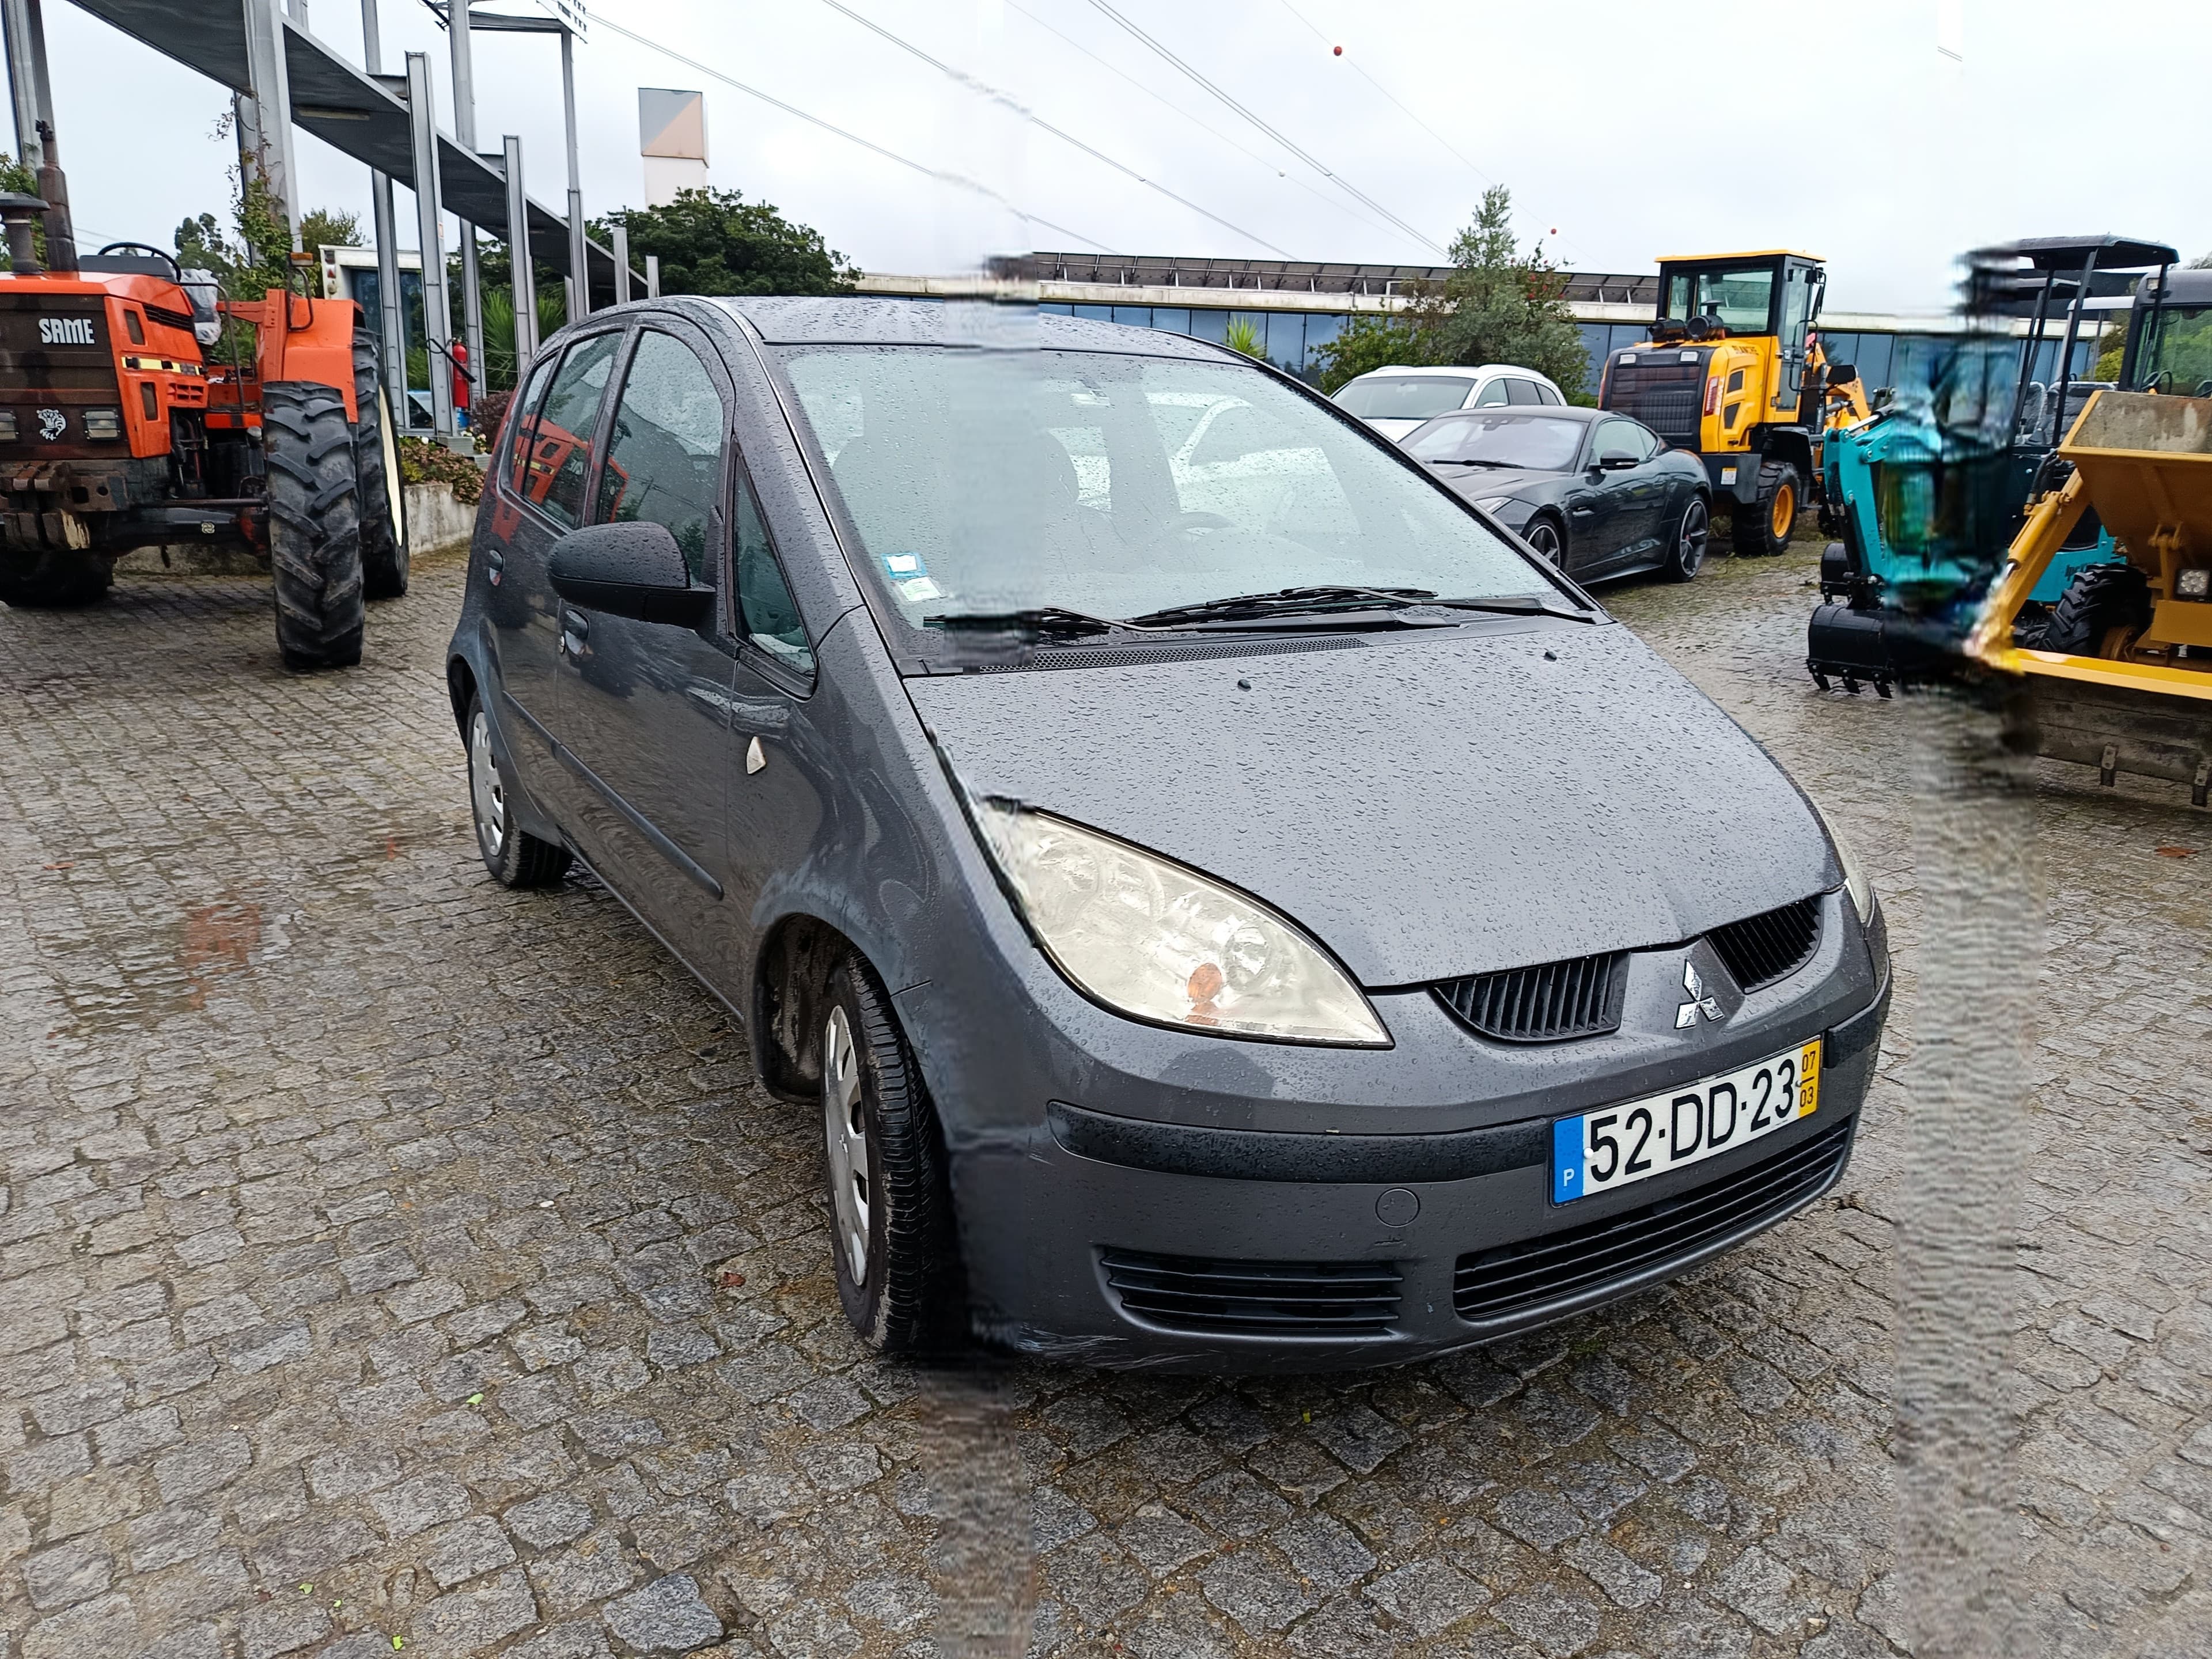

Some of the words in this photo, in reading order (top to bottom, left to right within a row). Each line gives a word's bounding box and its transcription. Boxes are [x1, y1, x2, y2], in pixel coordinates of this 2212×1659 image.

[39, 318, 95, 344] SAME
[1802, 1050, 1816, 1073] 07
[1800, 1086, 1813, 1108] 03
[1563, 1168, 1574, 1187] P
